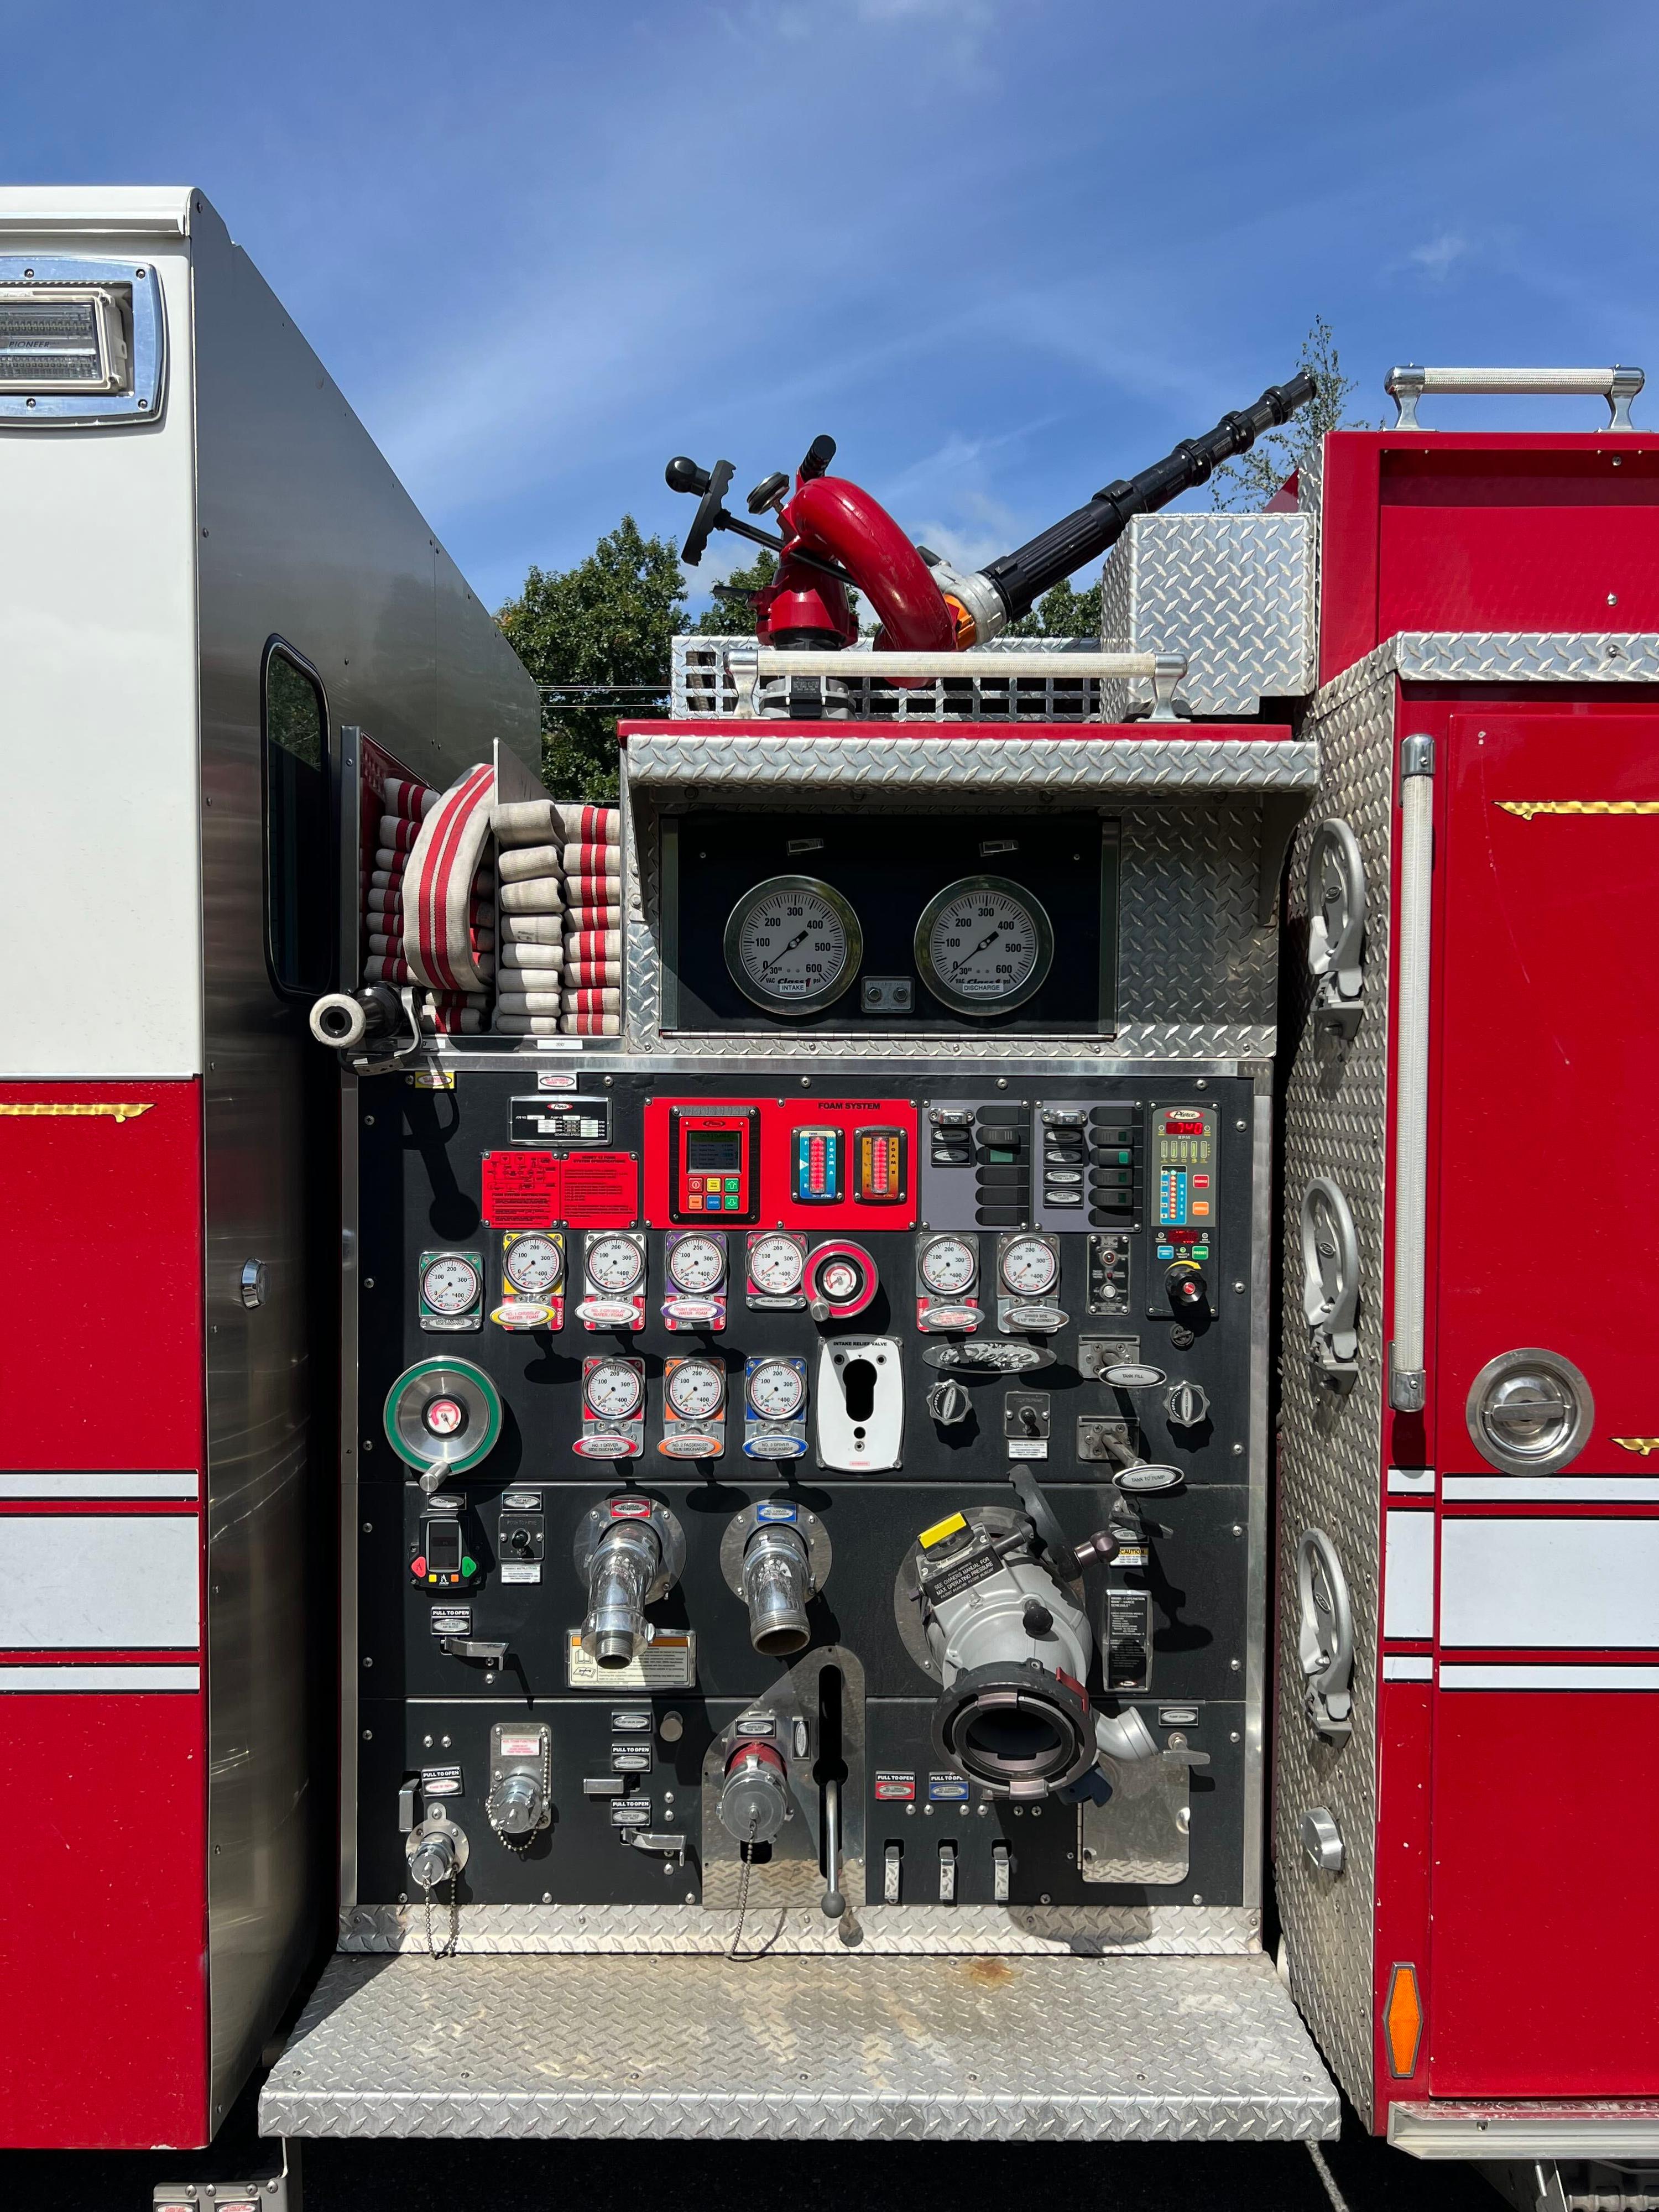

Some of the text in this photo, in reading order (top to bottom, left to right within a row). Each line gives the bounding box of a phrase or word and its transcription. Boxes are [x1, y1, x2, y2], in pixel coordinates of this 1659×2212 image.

[787, 907, 802, 916] 300
[978, 908, 994, 916] 300
[765, 918, 780, 926] 200
[807, 921, 823, 929] 400
[956, 919, 971, 927] 200
[998, 921, 1014, 930] 400
[815, 943, 831, 951] 500
[946, 939, 960, 947] 100
[1005, 944, 1021, 952] 500
[763, 961, 768, 969] 0
[806, 964, 822, 972] 600
[953, 961, 958, 970] 0
[997, 965, 1012, 973] 600
[1180, 1123, 1202, 1134] 740
[943, 1572, 962, 1584] OWNERS
[962, 1563, 980, 1574] MANUAL
[936, 1561, 993, 1595] MAX OPERATING PRESSURE
